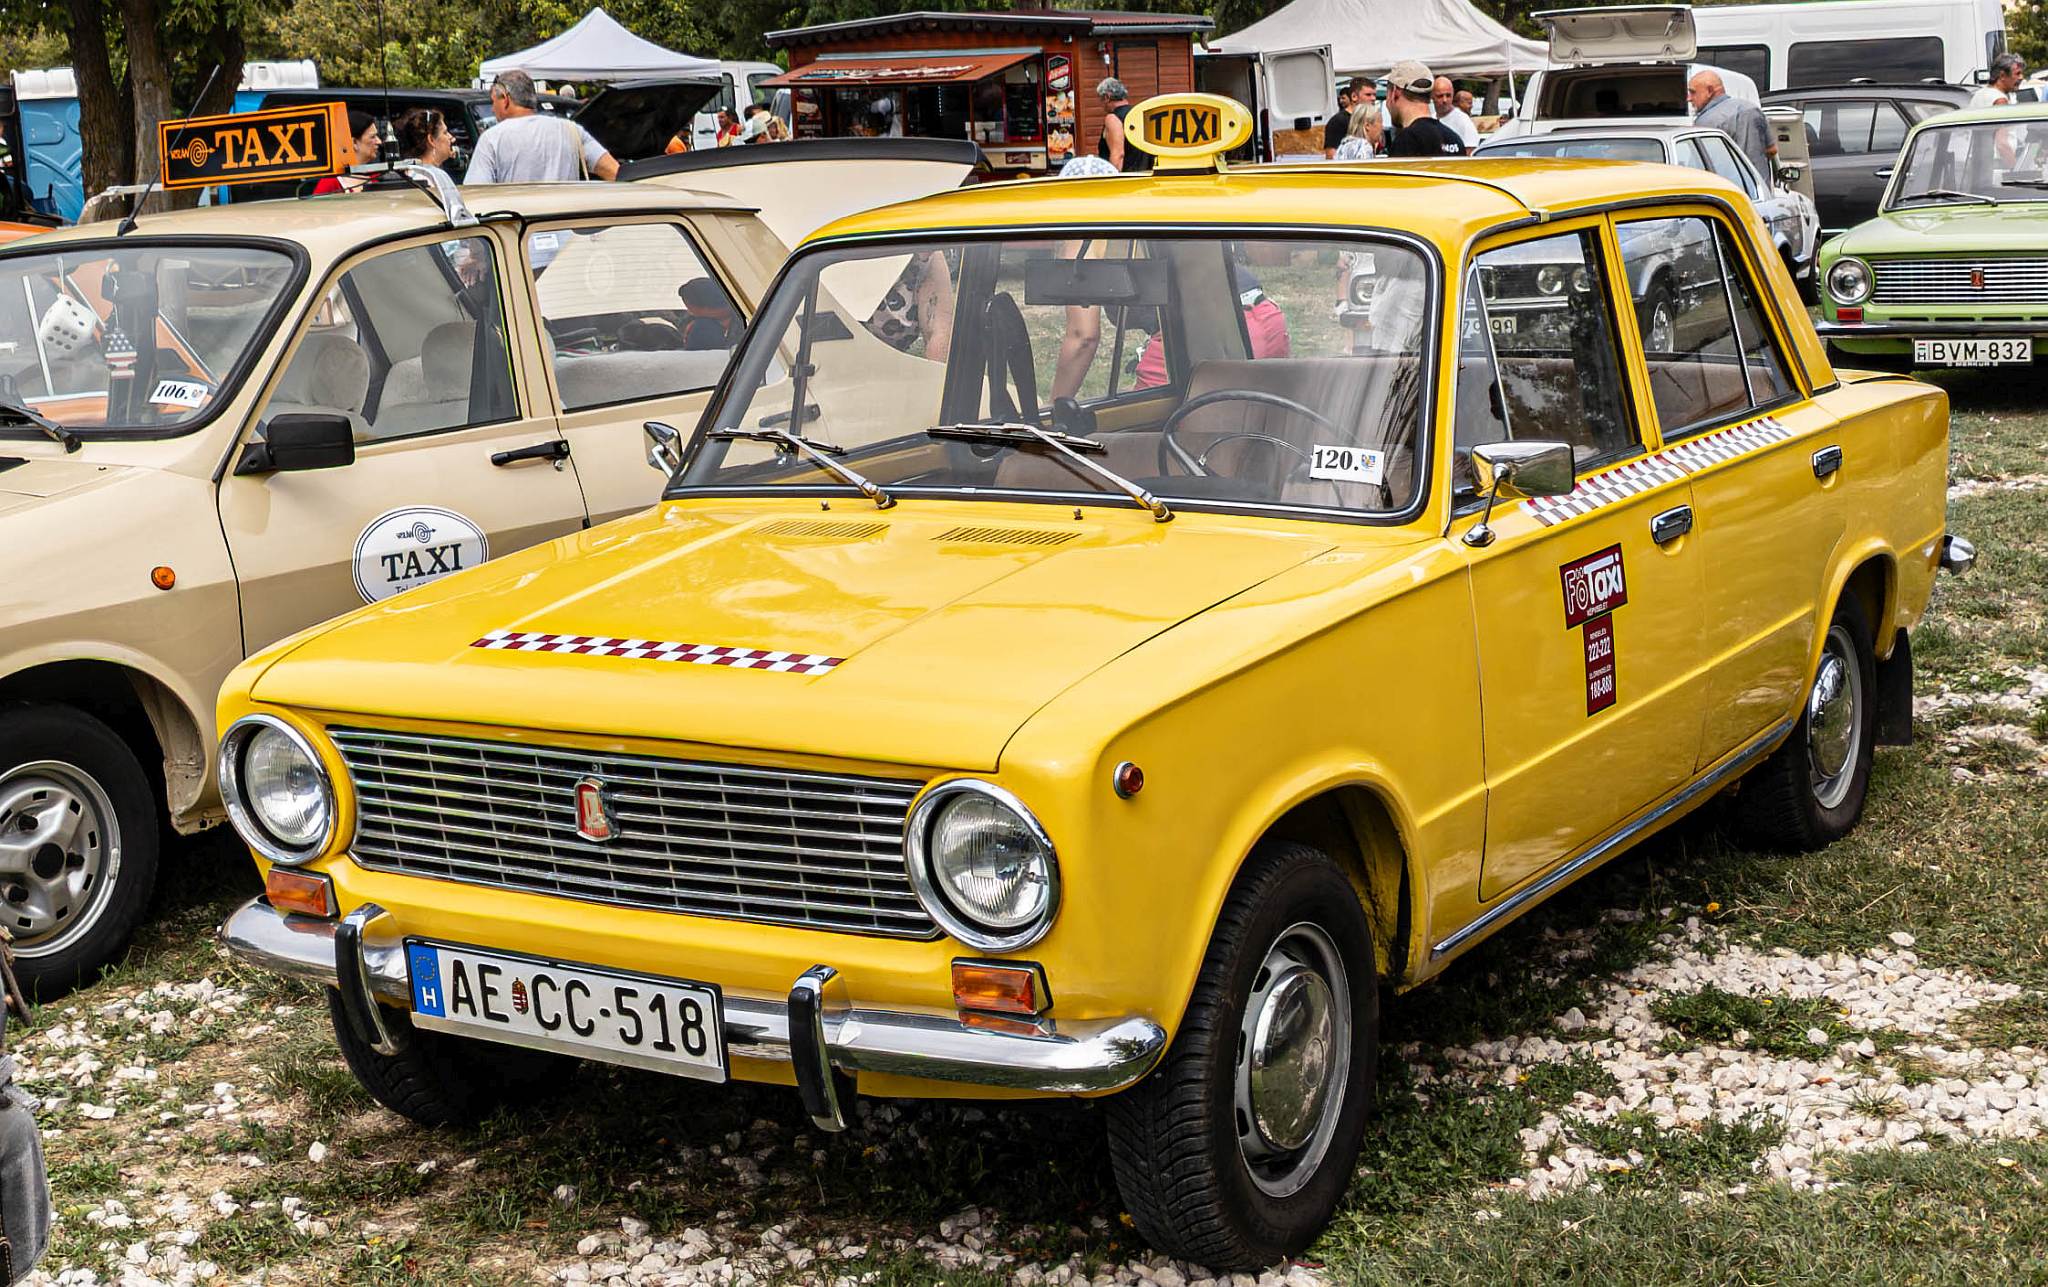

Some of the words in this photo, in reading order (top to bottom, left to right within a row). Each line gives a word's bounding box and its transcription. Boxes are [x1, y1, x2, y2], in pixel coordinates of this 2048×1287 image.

[1150, 109, 1218, 144] TAXI
[215, 122, 317, 169] TAXI
[1932, 342, 2028, 361] BVM-832
[1314, 449, 1359, 471] 120.
[381, 543, 463, 582] TAXI
[1588, 637, 1611, 662] 222-222
[421, 985, 438, 1009] H
[452, 959, 510, 1023] AE
